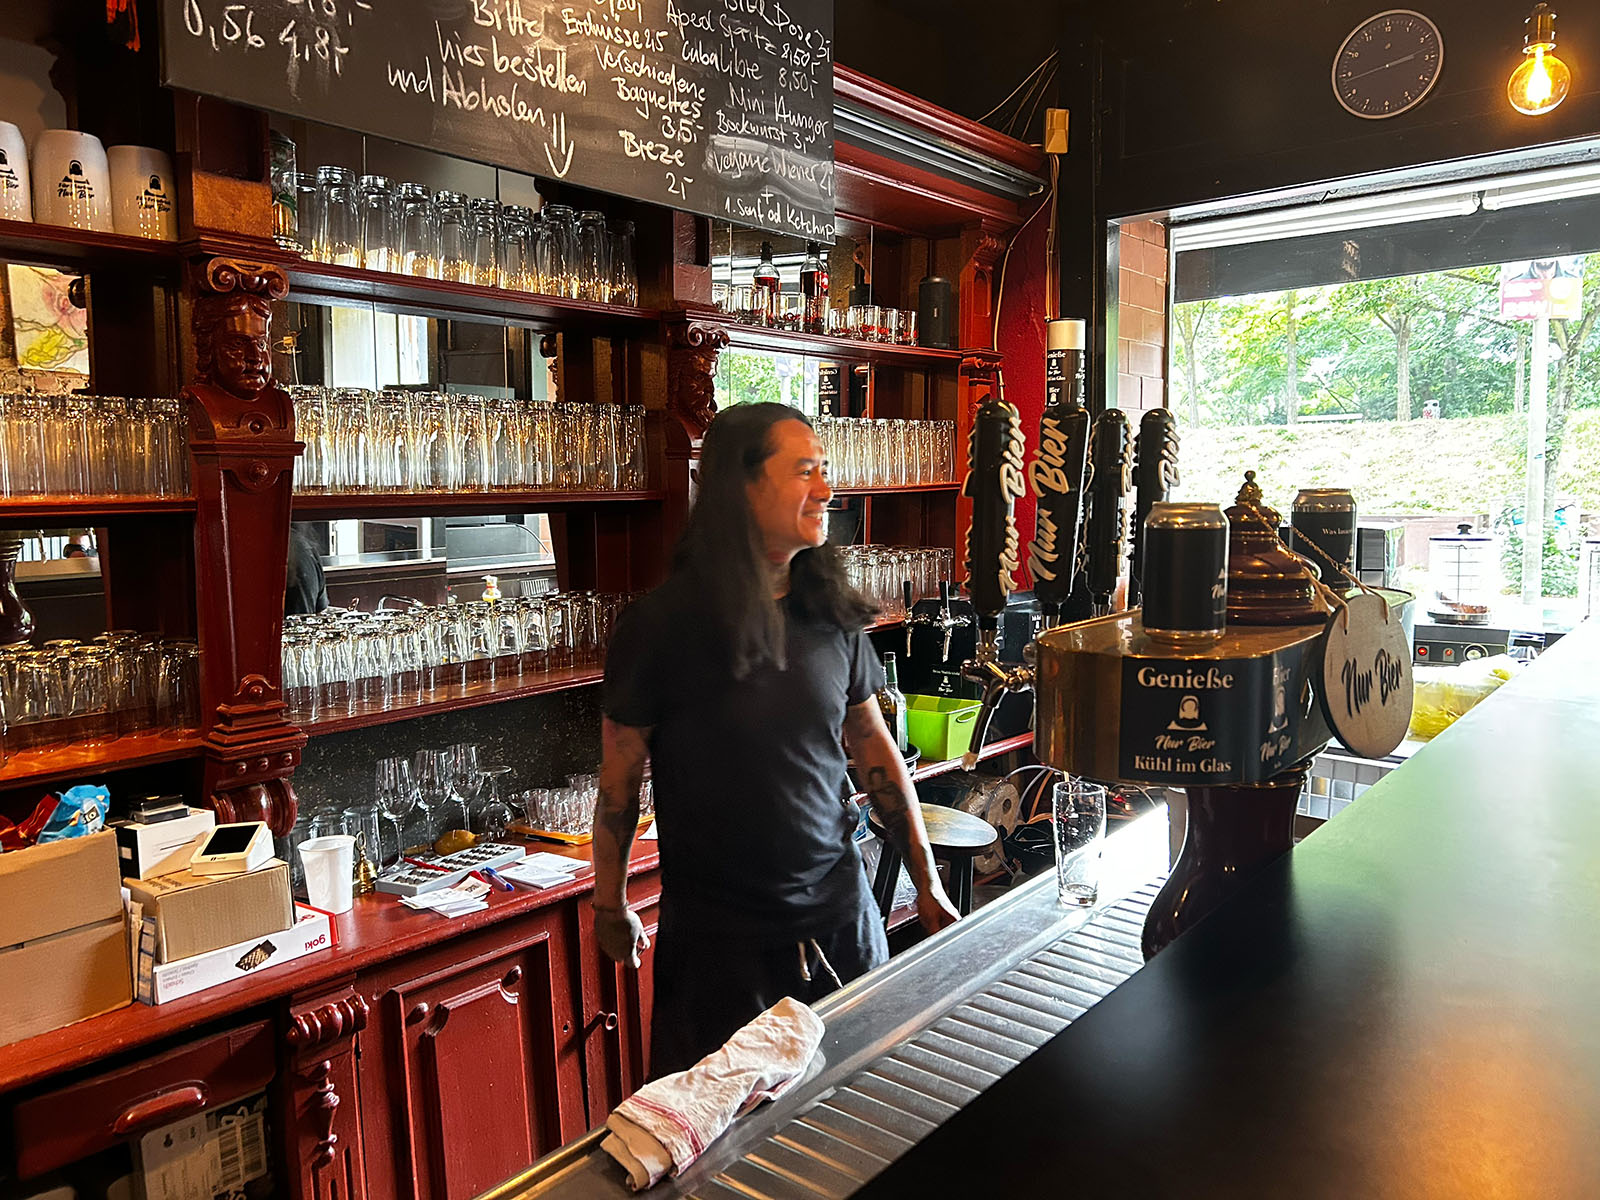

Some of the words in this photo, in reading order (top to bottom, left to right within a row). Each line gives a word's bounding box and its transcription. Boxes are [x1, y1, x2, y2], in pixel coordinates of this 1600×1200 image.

[772, 2, 813, 49] Dose
[388, 56, 436, 102] und
[492, 35, 587, 97] bestellen
[611, 76, 703, 119] Baguettes
[729, 82, 765, 116] Mini
[716, 109, 788, 143] Bockwurst
[618, 129, 686, 167] Breze
[771, 149, 819, 181] Wiener
[737, 197, 764, 224] Senf
[786, 203, 835, 240] Ketchup
[1028, 417, 1069, 498] Bier
[1026, 508, 1060, 583] Nur
[1137, 667, 1234, 690] Genieße
[1341, 657, 1374, 719] Nur
[1374, 647, 1402, 707] Bier
[1134, 754, 1173, 773] Kühl
[1176, 757, 1197, 773] im
[1199, 757, 1232, 774] Glas
[1154, 734, 1184, 750] Nur
[1188, 735, 1216, 753] Bier
